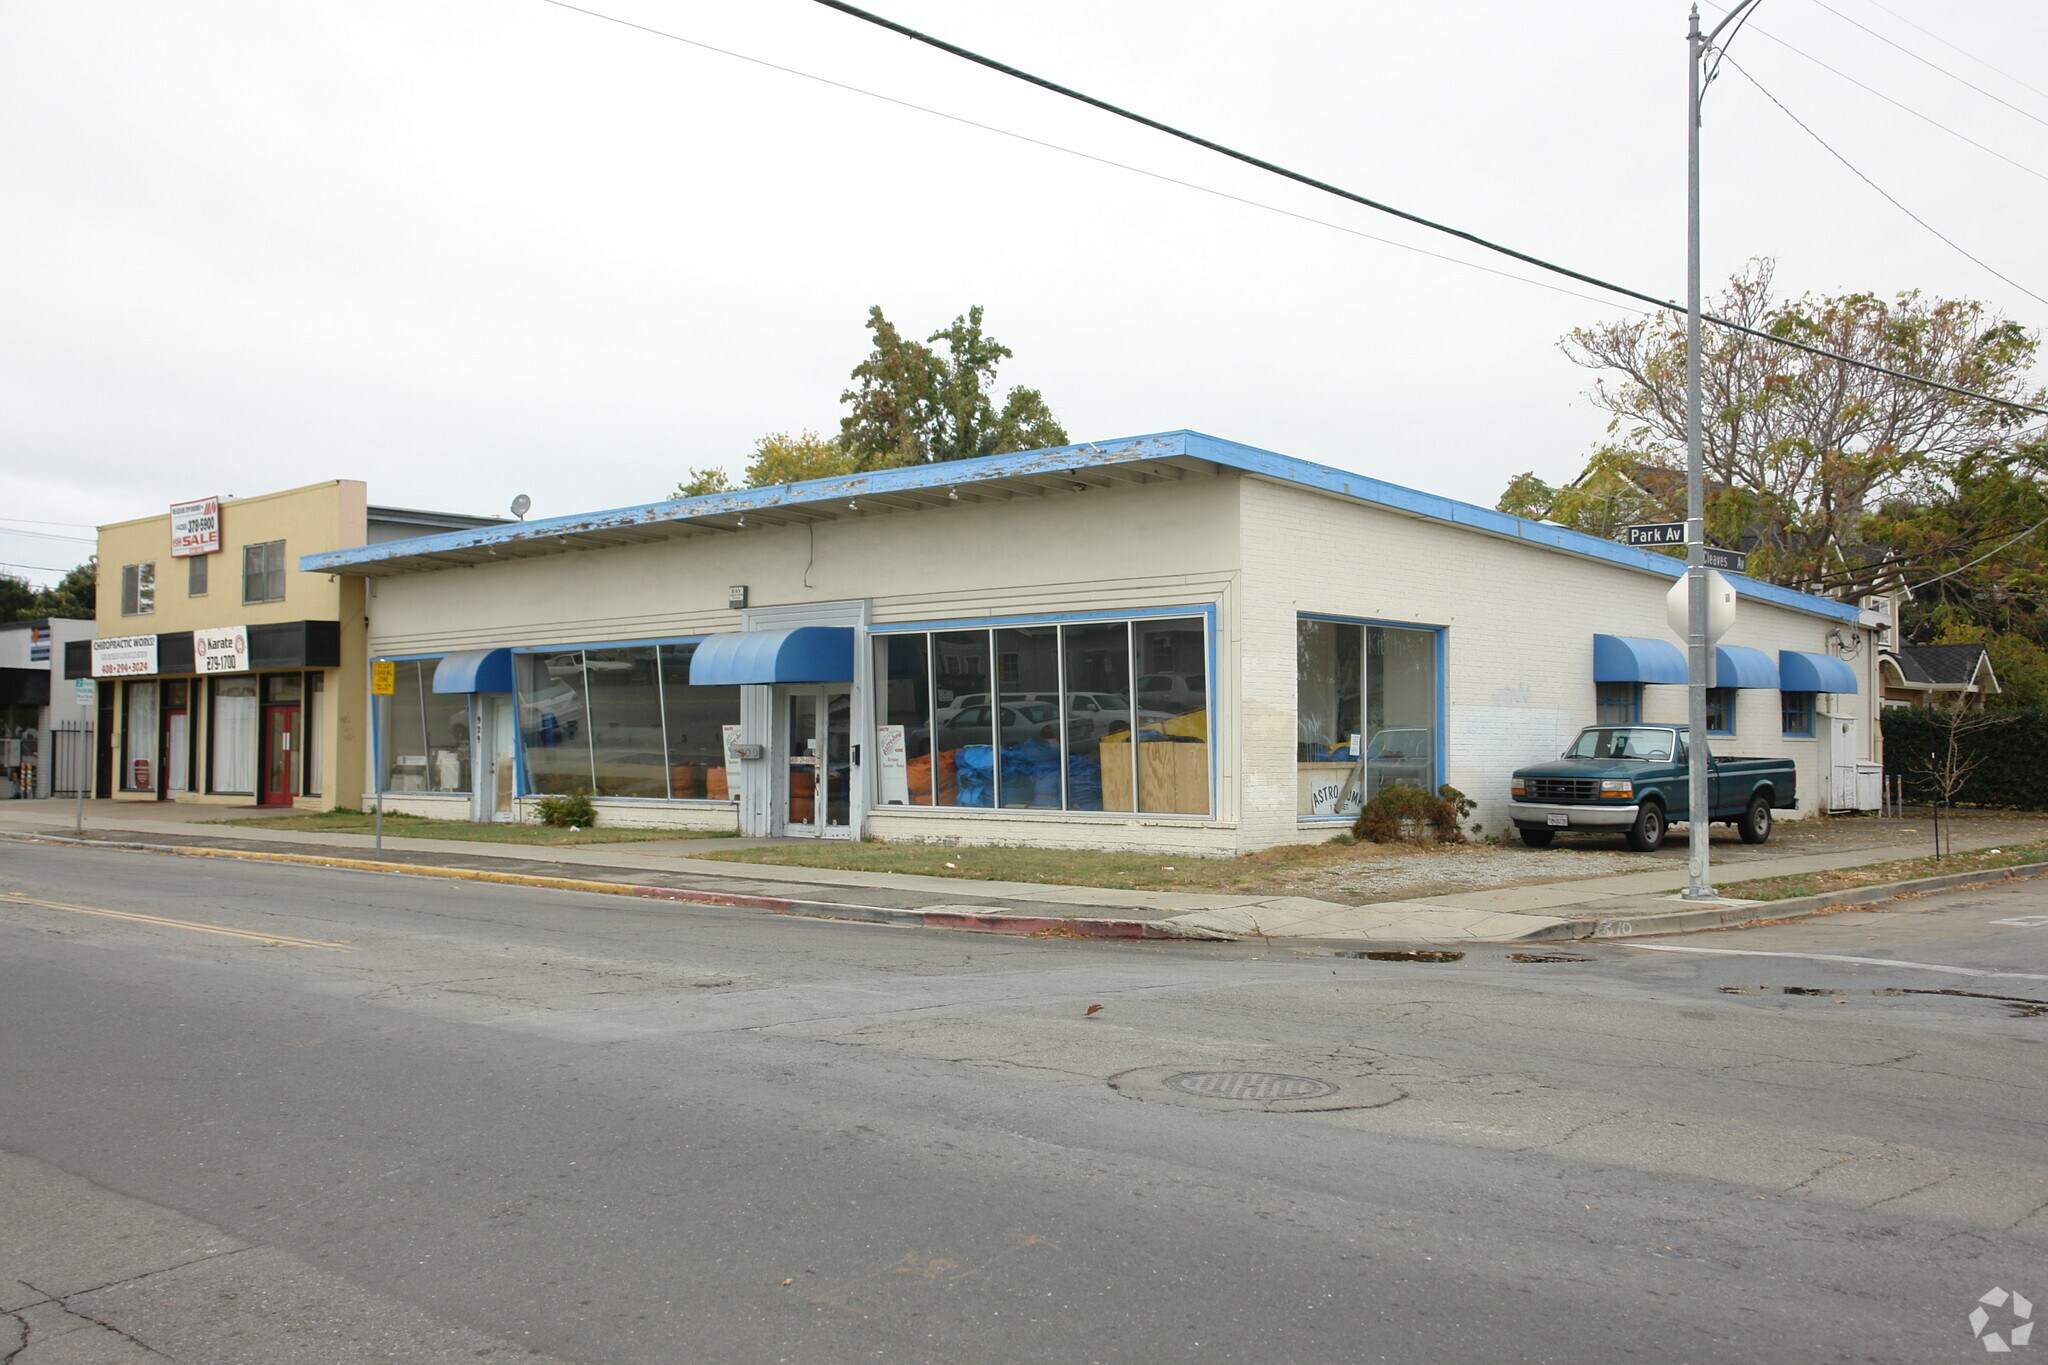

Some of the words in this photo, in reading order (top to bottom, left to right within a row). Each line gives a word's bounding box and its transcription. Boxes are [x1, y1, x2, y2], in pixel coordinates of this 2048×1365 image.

[182, 531, 217, 547] SALE
[1631, 528, 1661, 543] Park
[1666, 527, 1681, 541] Av
[1703, 550, 1728, 568] Cleaves
[1737, 557, 1745, 570] Av
[94, 639, 132, 650] CHIROPRACTIC
[207, 637, 233, 650] Karate
[207, 655, 236, 671] 279-1700
[1313, 785, 1338, 808] ASTRO
